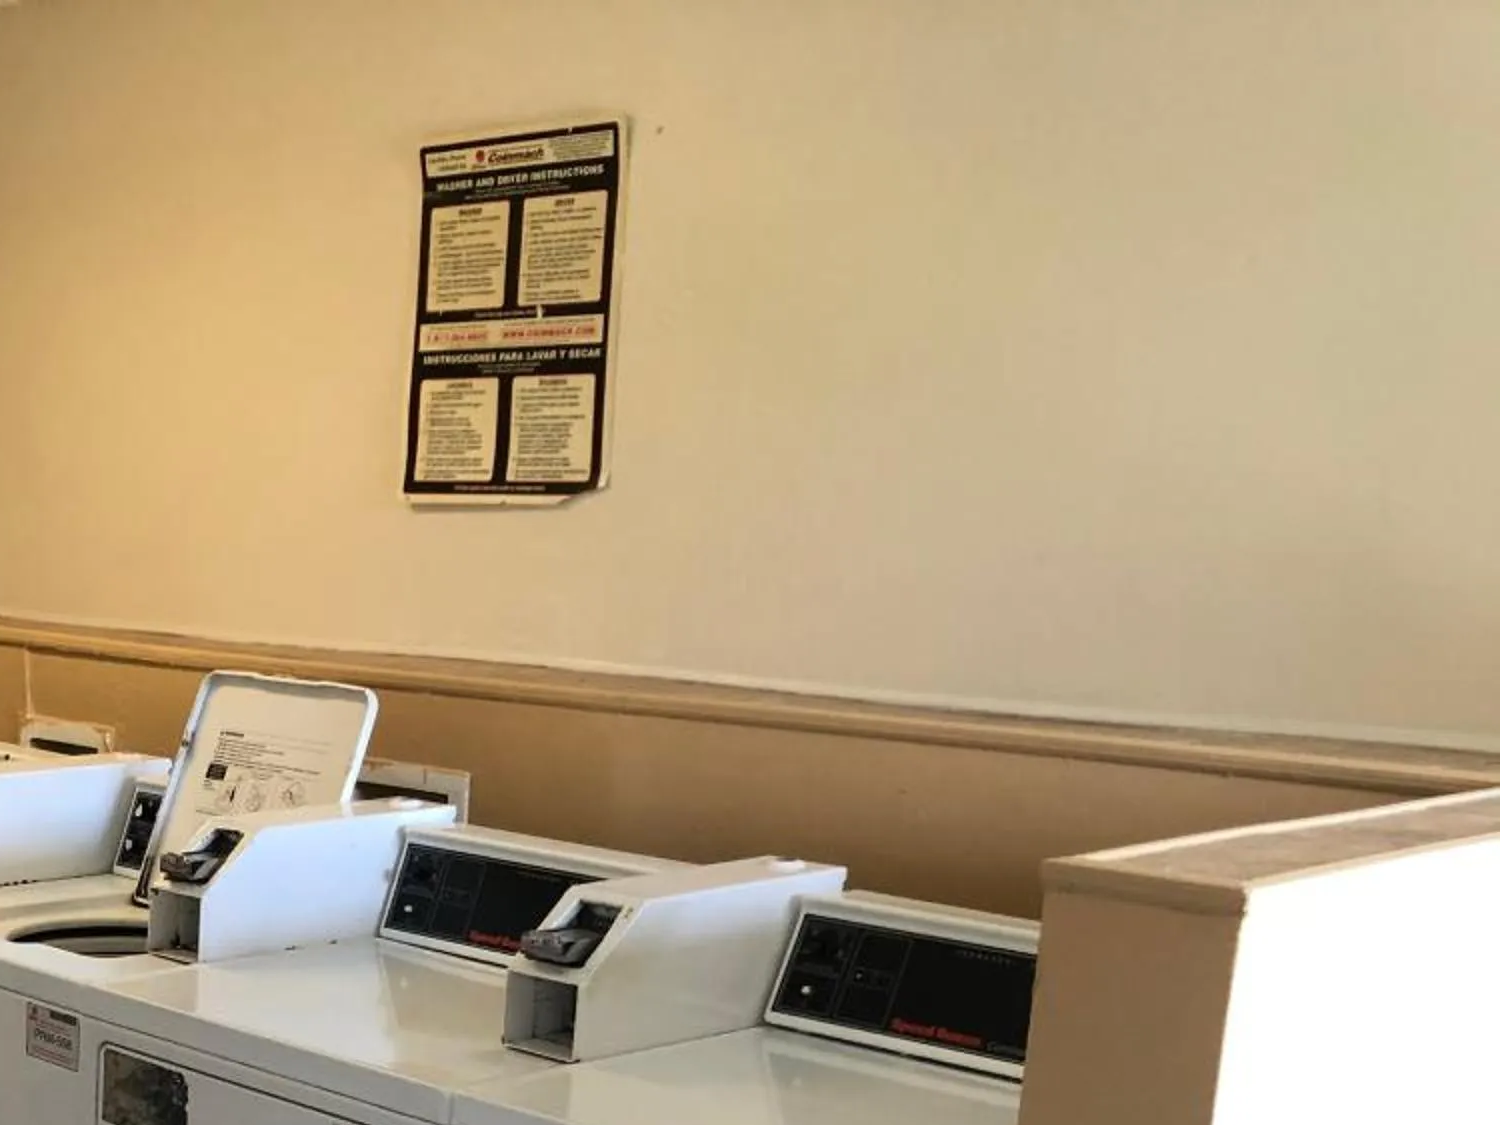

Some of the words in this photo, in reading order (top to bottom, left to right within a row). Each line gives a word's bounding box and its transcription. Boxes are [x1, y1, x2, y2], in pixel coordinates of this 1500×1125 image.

[436, 178, 473, 192] WASHER
[476, 176, 494, 188] AND
[497, 172, 528, 186] DRYER
[530, 164, 604, 181] INSTRUCTIONS
[423, 351, 496, 365] INSTRUCCIONES
[500, 350, 523, 362] PARA
[526, 349, 557, 361] LAVAR
[569, 347, 601, 359] SECAR
